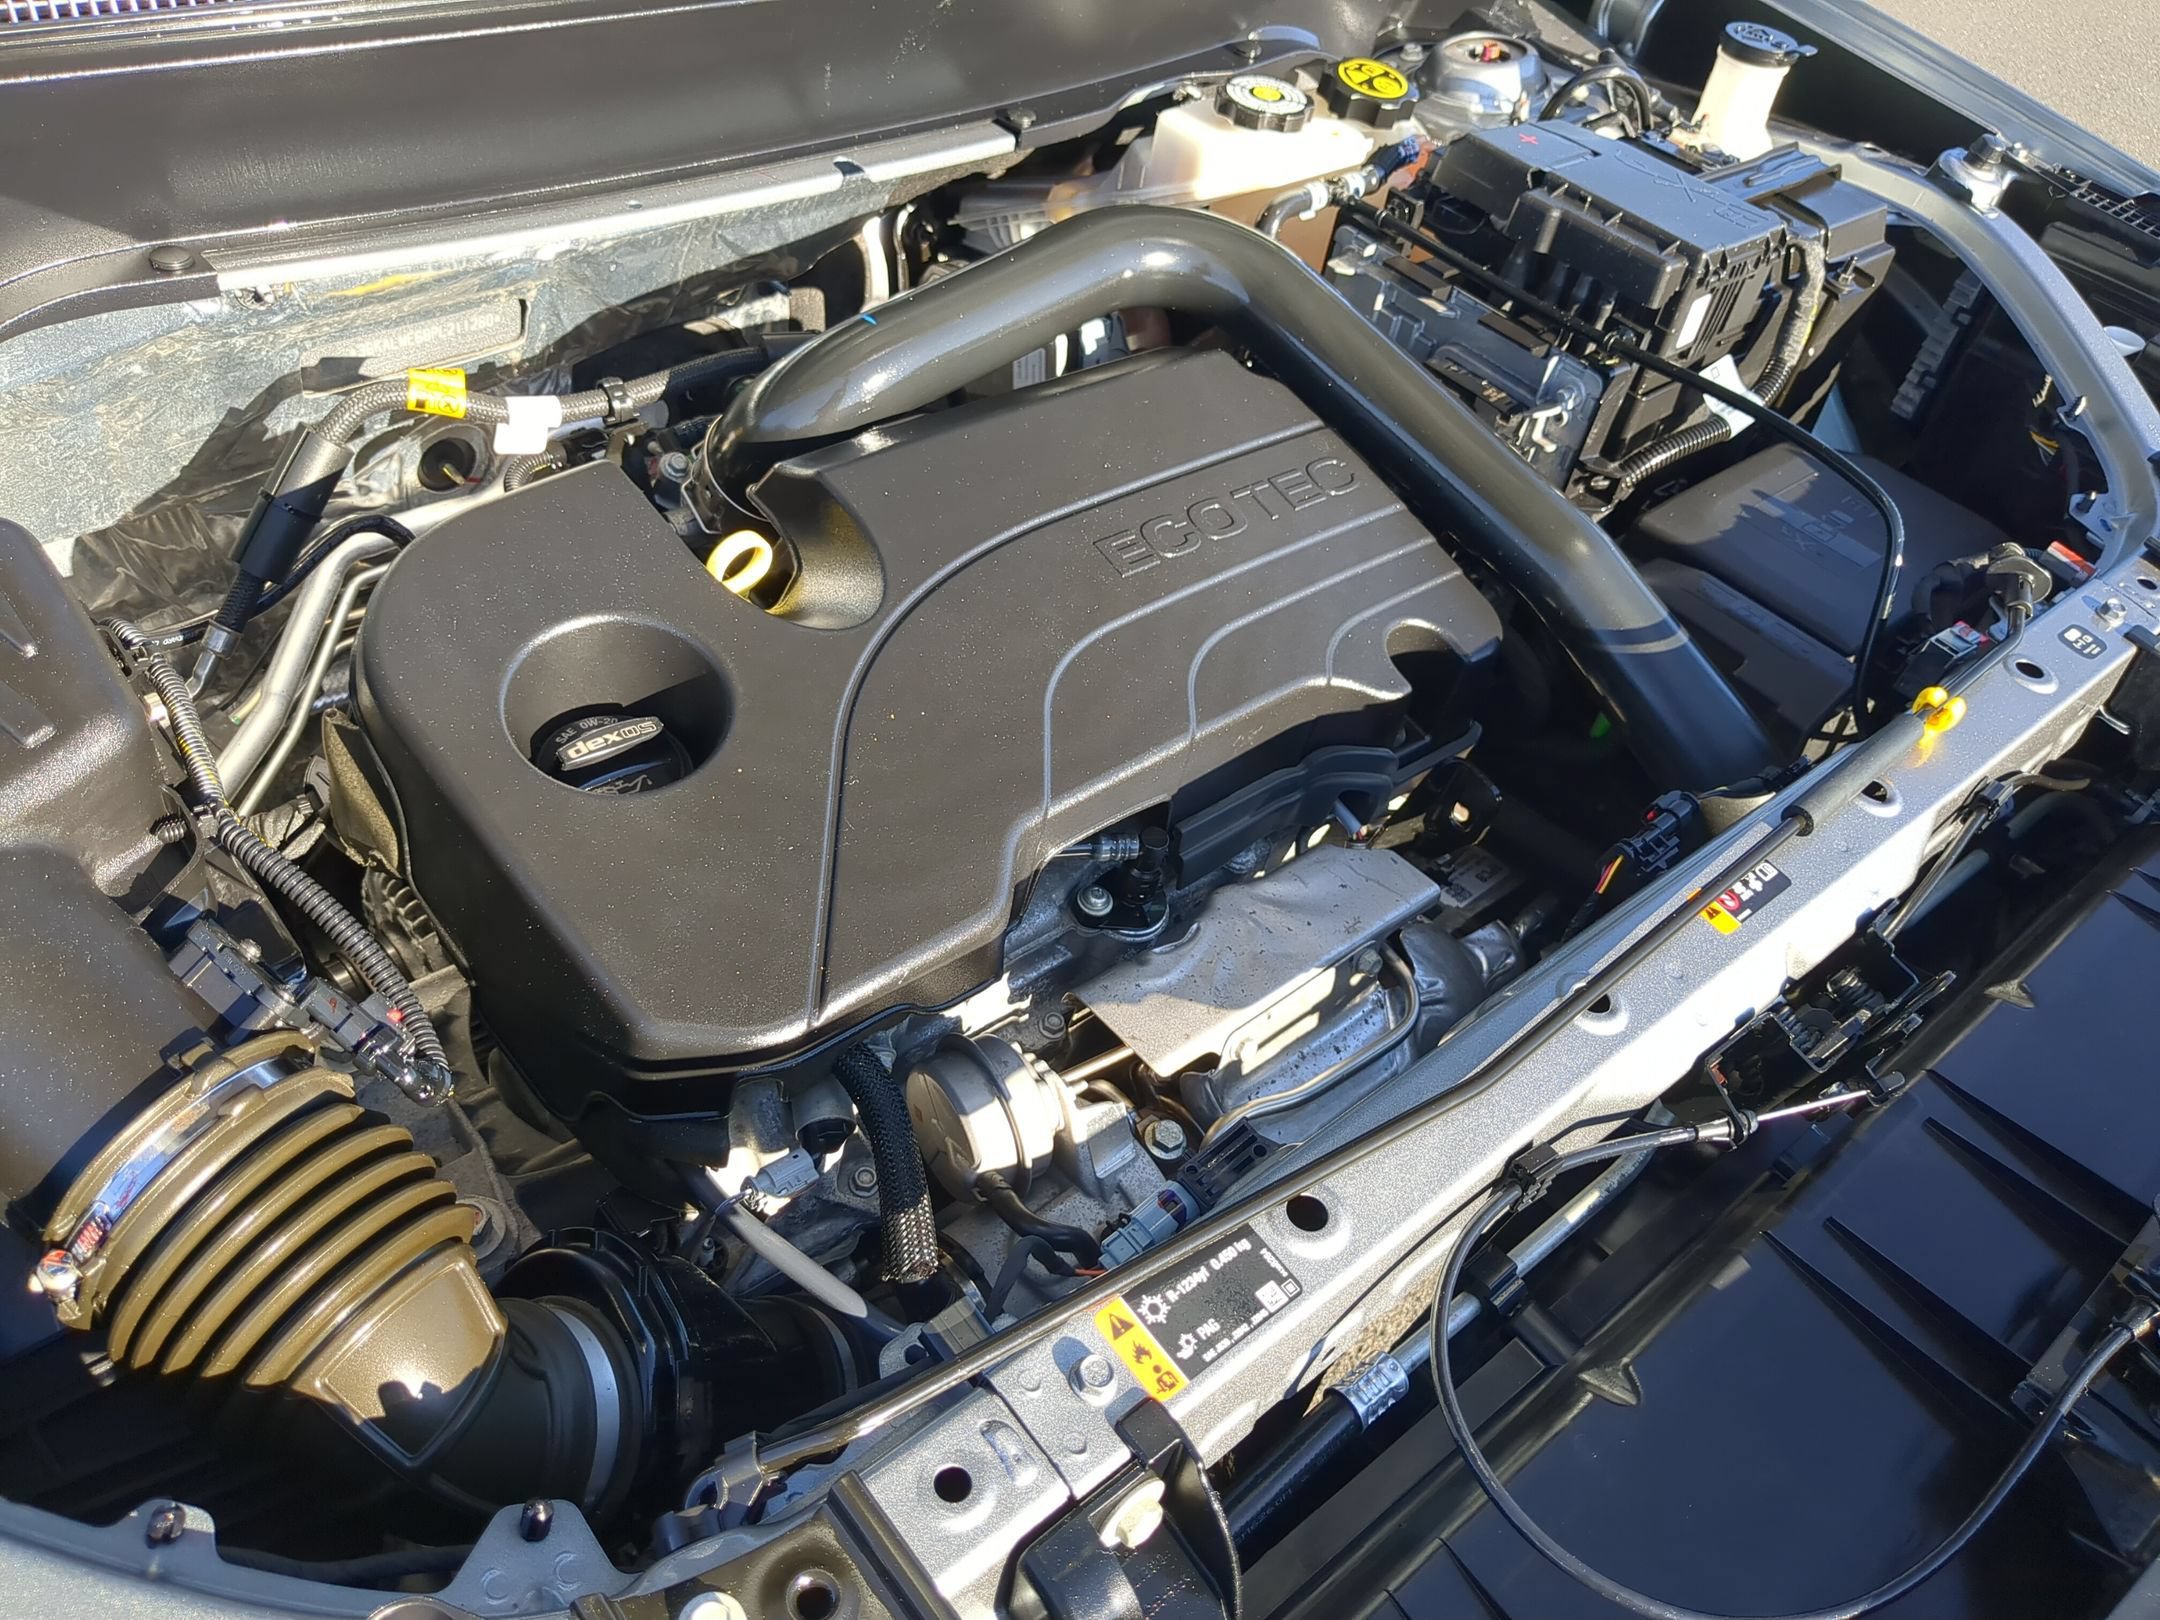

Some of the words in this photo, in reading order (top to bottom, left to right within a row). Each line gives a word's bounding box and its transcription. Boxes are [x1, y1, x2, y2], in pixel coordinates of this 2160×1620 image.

[1092, 456, 1360, 578] ECOTEC
[555, 727, 577, 744] SAE
[567, 721, 657, 759] dexos
[1165, 1266, 1210, 1302] R-1234yf
[1209, 1245, 1237, 1270] 0.450
[1235, 1238, 1252, 1252] kg
[1197, 1318, 1221, 1340] PAG
